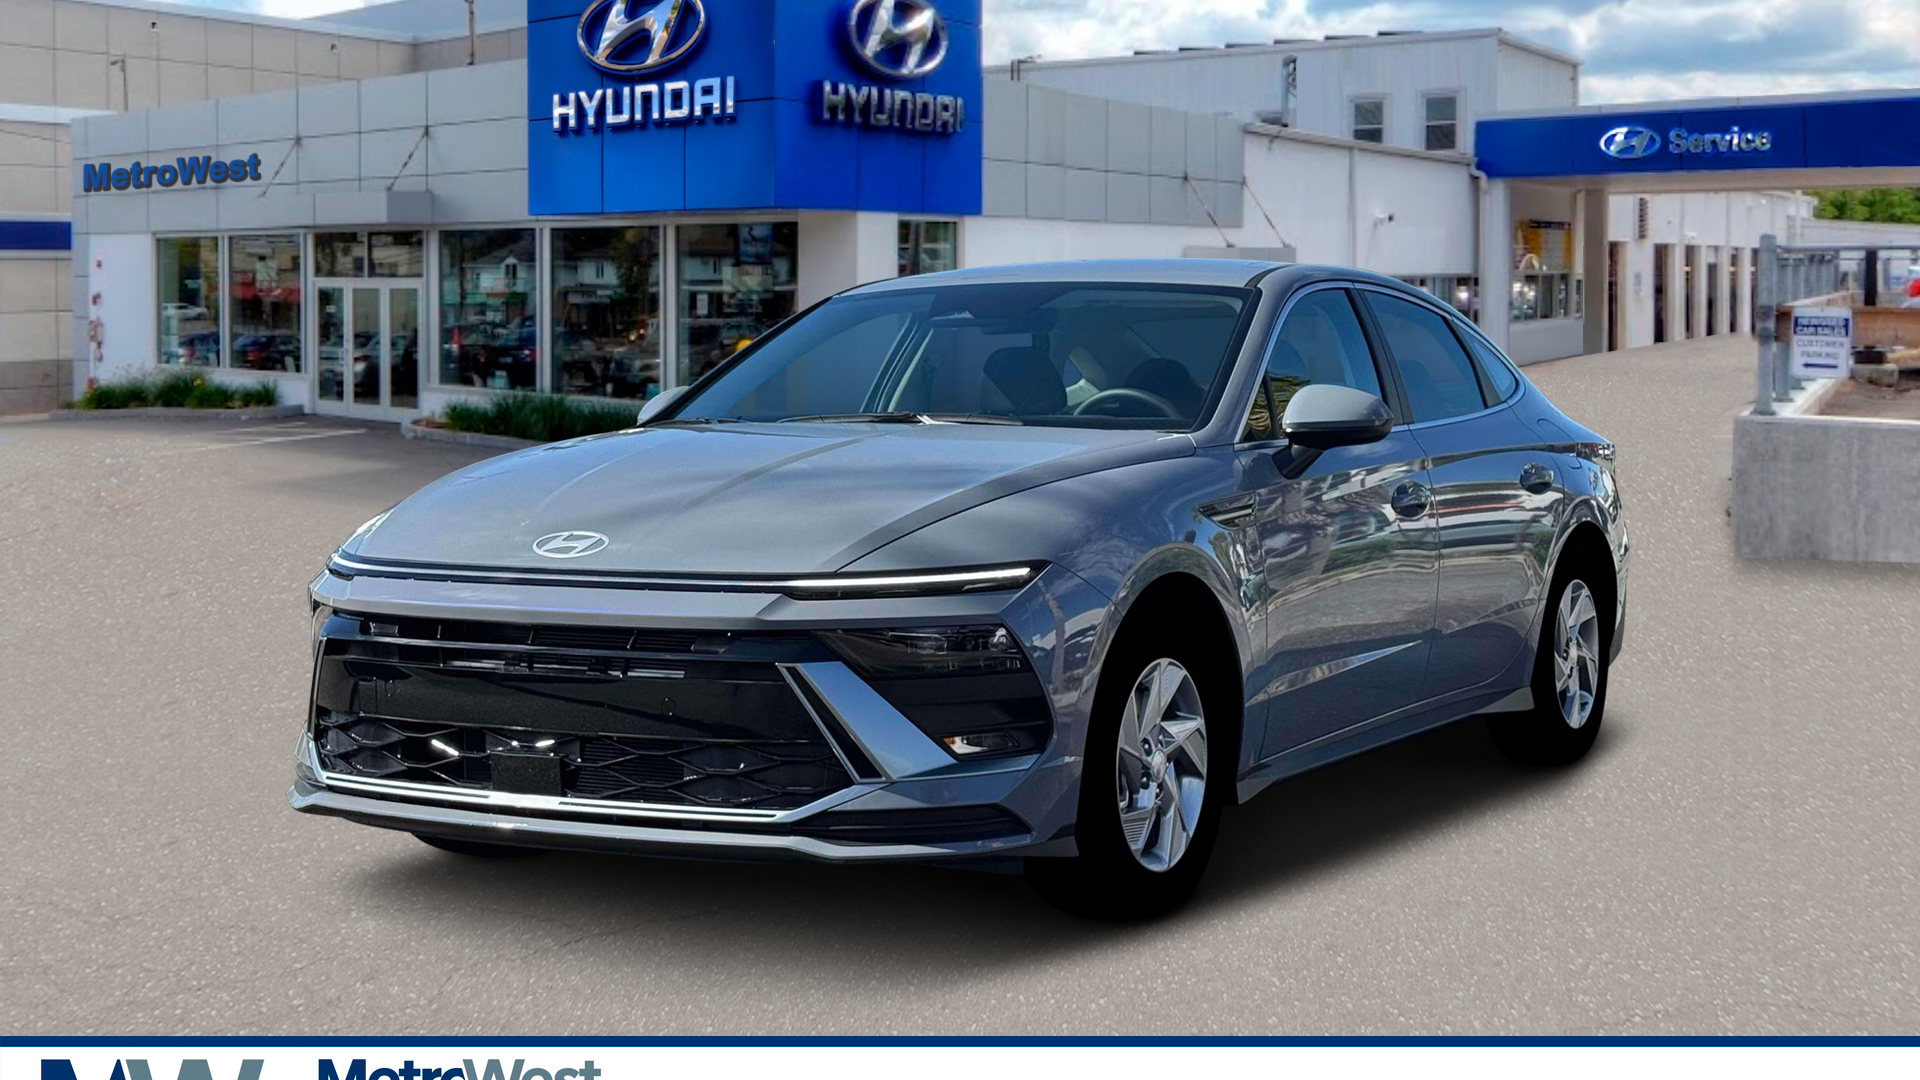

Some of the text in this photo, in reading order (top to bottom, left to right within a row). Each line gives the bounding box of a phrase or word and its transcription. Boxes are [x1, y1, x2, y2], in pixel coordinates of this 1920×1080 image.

[553, 75, 735, 130] HYUNDAI
[823, 80, 964, 133] HYUNDAI
[1668, 125, 1772, 154] Service
[83, 153, 262, 193] MetroWest
[1796, 339, 1845, 348] CUSTOMER
[1800, 350, 1840, 360] PARKING
